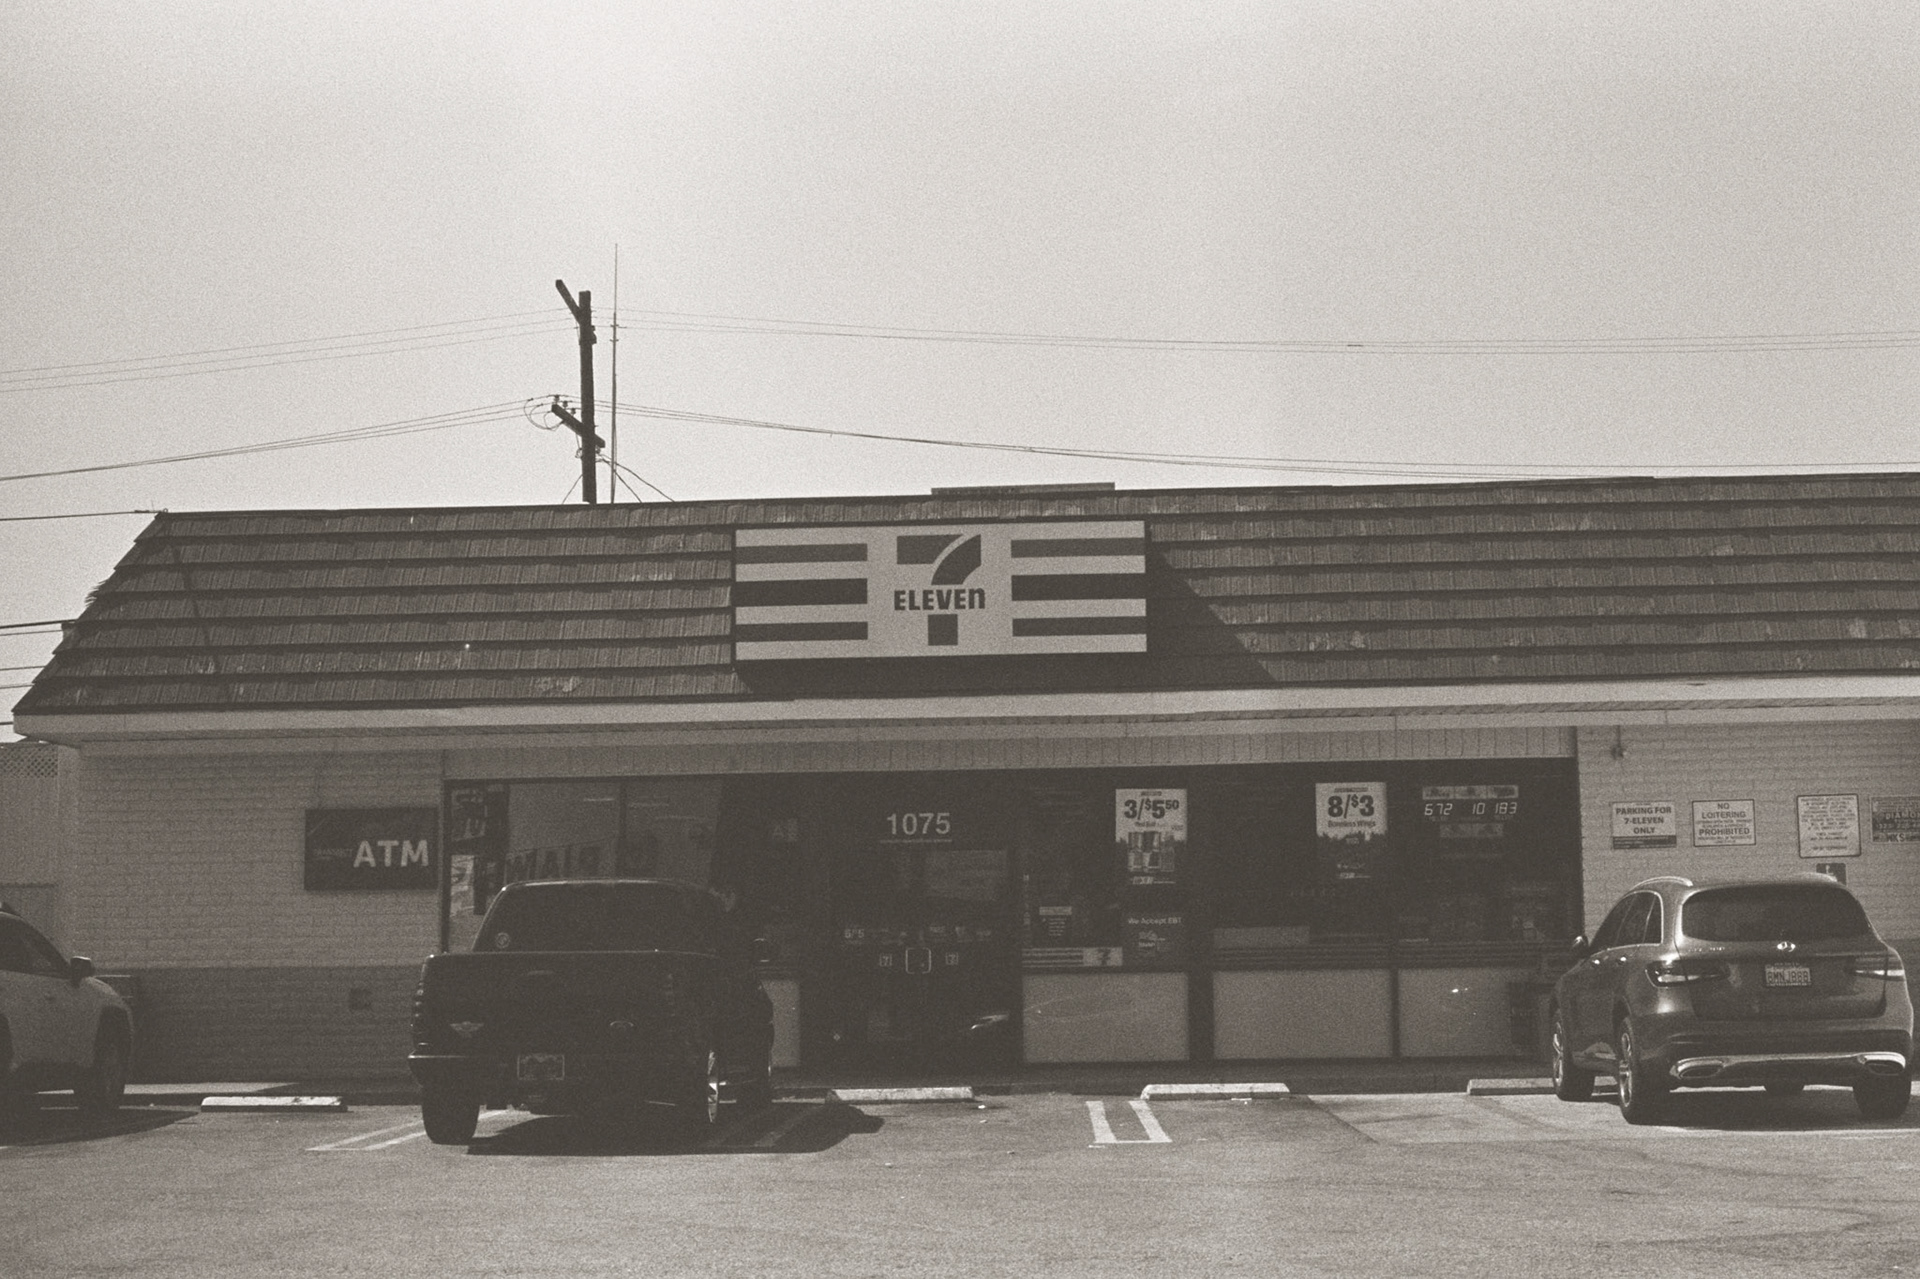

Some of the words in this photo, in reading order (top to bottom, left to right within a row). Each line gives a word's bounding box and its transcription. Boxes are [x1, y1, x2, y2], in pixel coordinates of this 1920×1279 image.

[896, 534, 981, 646] 7
[1327, 794, 1375, 819] 8/$3
[1424, 802, 1453, 816] 672
[1472, 802, 1486, 815] 10
[1494, 801, 1518, 814] 183
[1616, 806, 1653, 815] PARKING
[1654, 806, 1672, 814] FOR
[1717, 802, 1730, 810] NO
[1623, 816, 1664, 824] 7-ELEVEN
[1701, 811, 1747, 819] LOITERING
[886, 812, 951, 835] 1075
[1698, 828, 1750, 836] PROHIBITED
[353, 840, 429, 868] ATM
